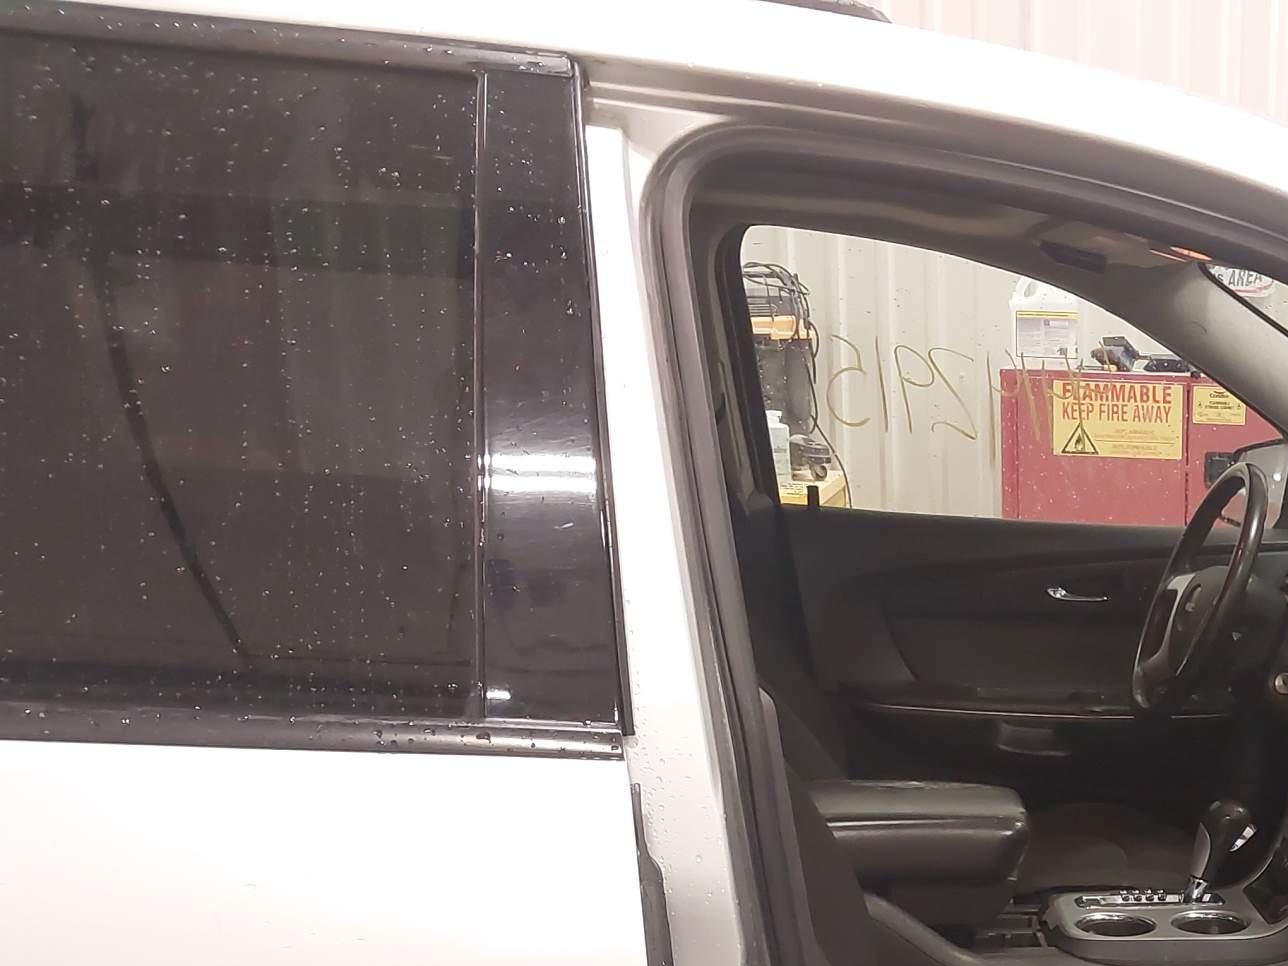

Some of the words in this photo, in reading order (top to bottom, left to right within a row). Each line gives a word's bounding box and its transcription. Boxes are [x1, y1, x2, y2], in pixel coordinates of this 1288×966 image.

[1062, 383, 1172, 404] FLAMMABLE
[1062, 401, 1095, 420] KEEP
[1099, 404, 1129, 422] FIRE
[1132, 405, 1172, 423] AWAY
